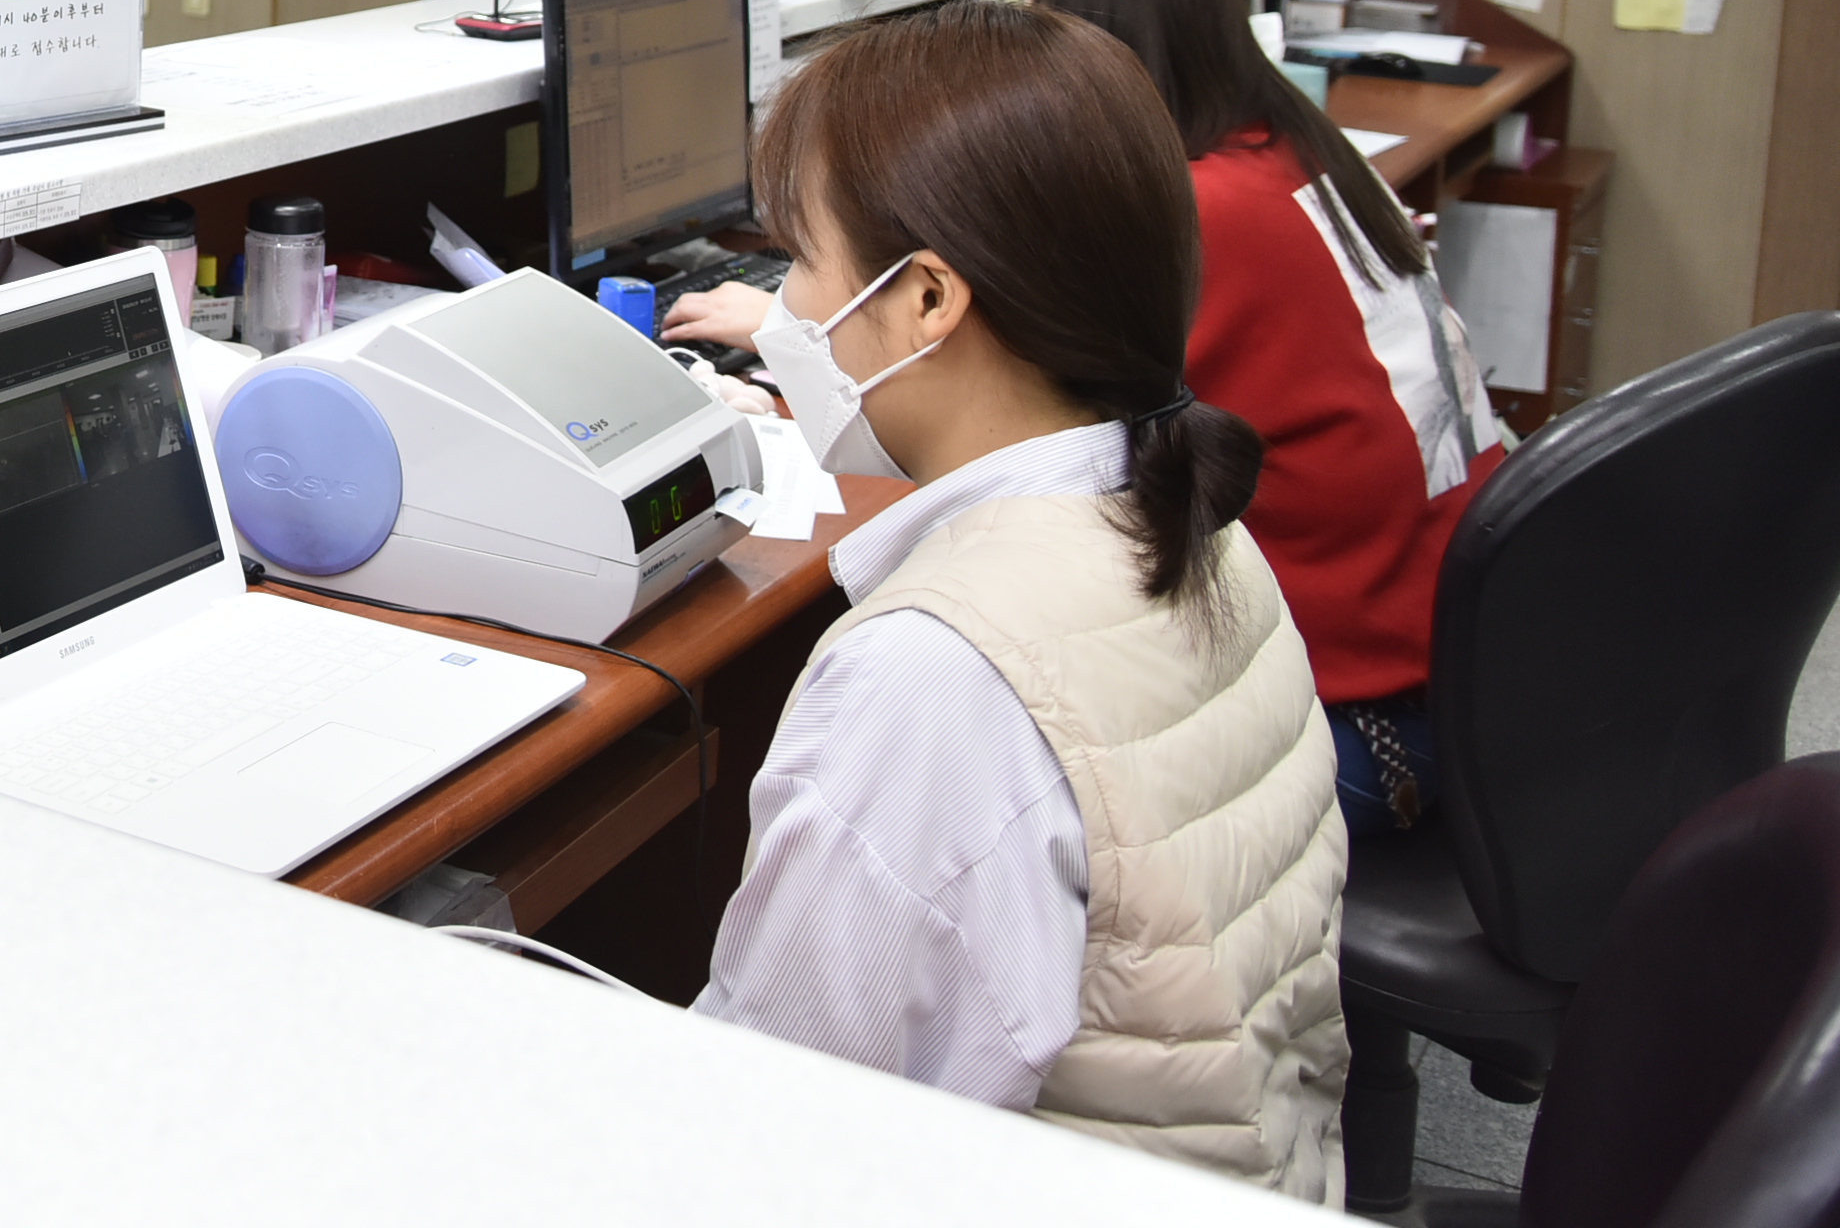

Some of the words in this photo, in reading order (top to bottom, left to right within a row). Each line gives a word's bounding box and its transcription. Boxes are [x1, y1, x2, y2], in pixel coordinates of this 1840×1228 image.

[566, 418, 609, 442] Qsys
[243, 446, 359, 500] Qsys
[58, 635, 95, 659] SAMSUNG
